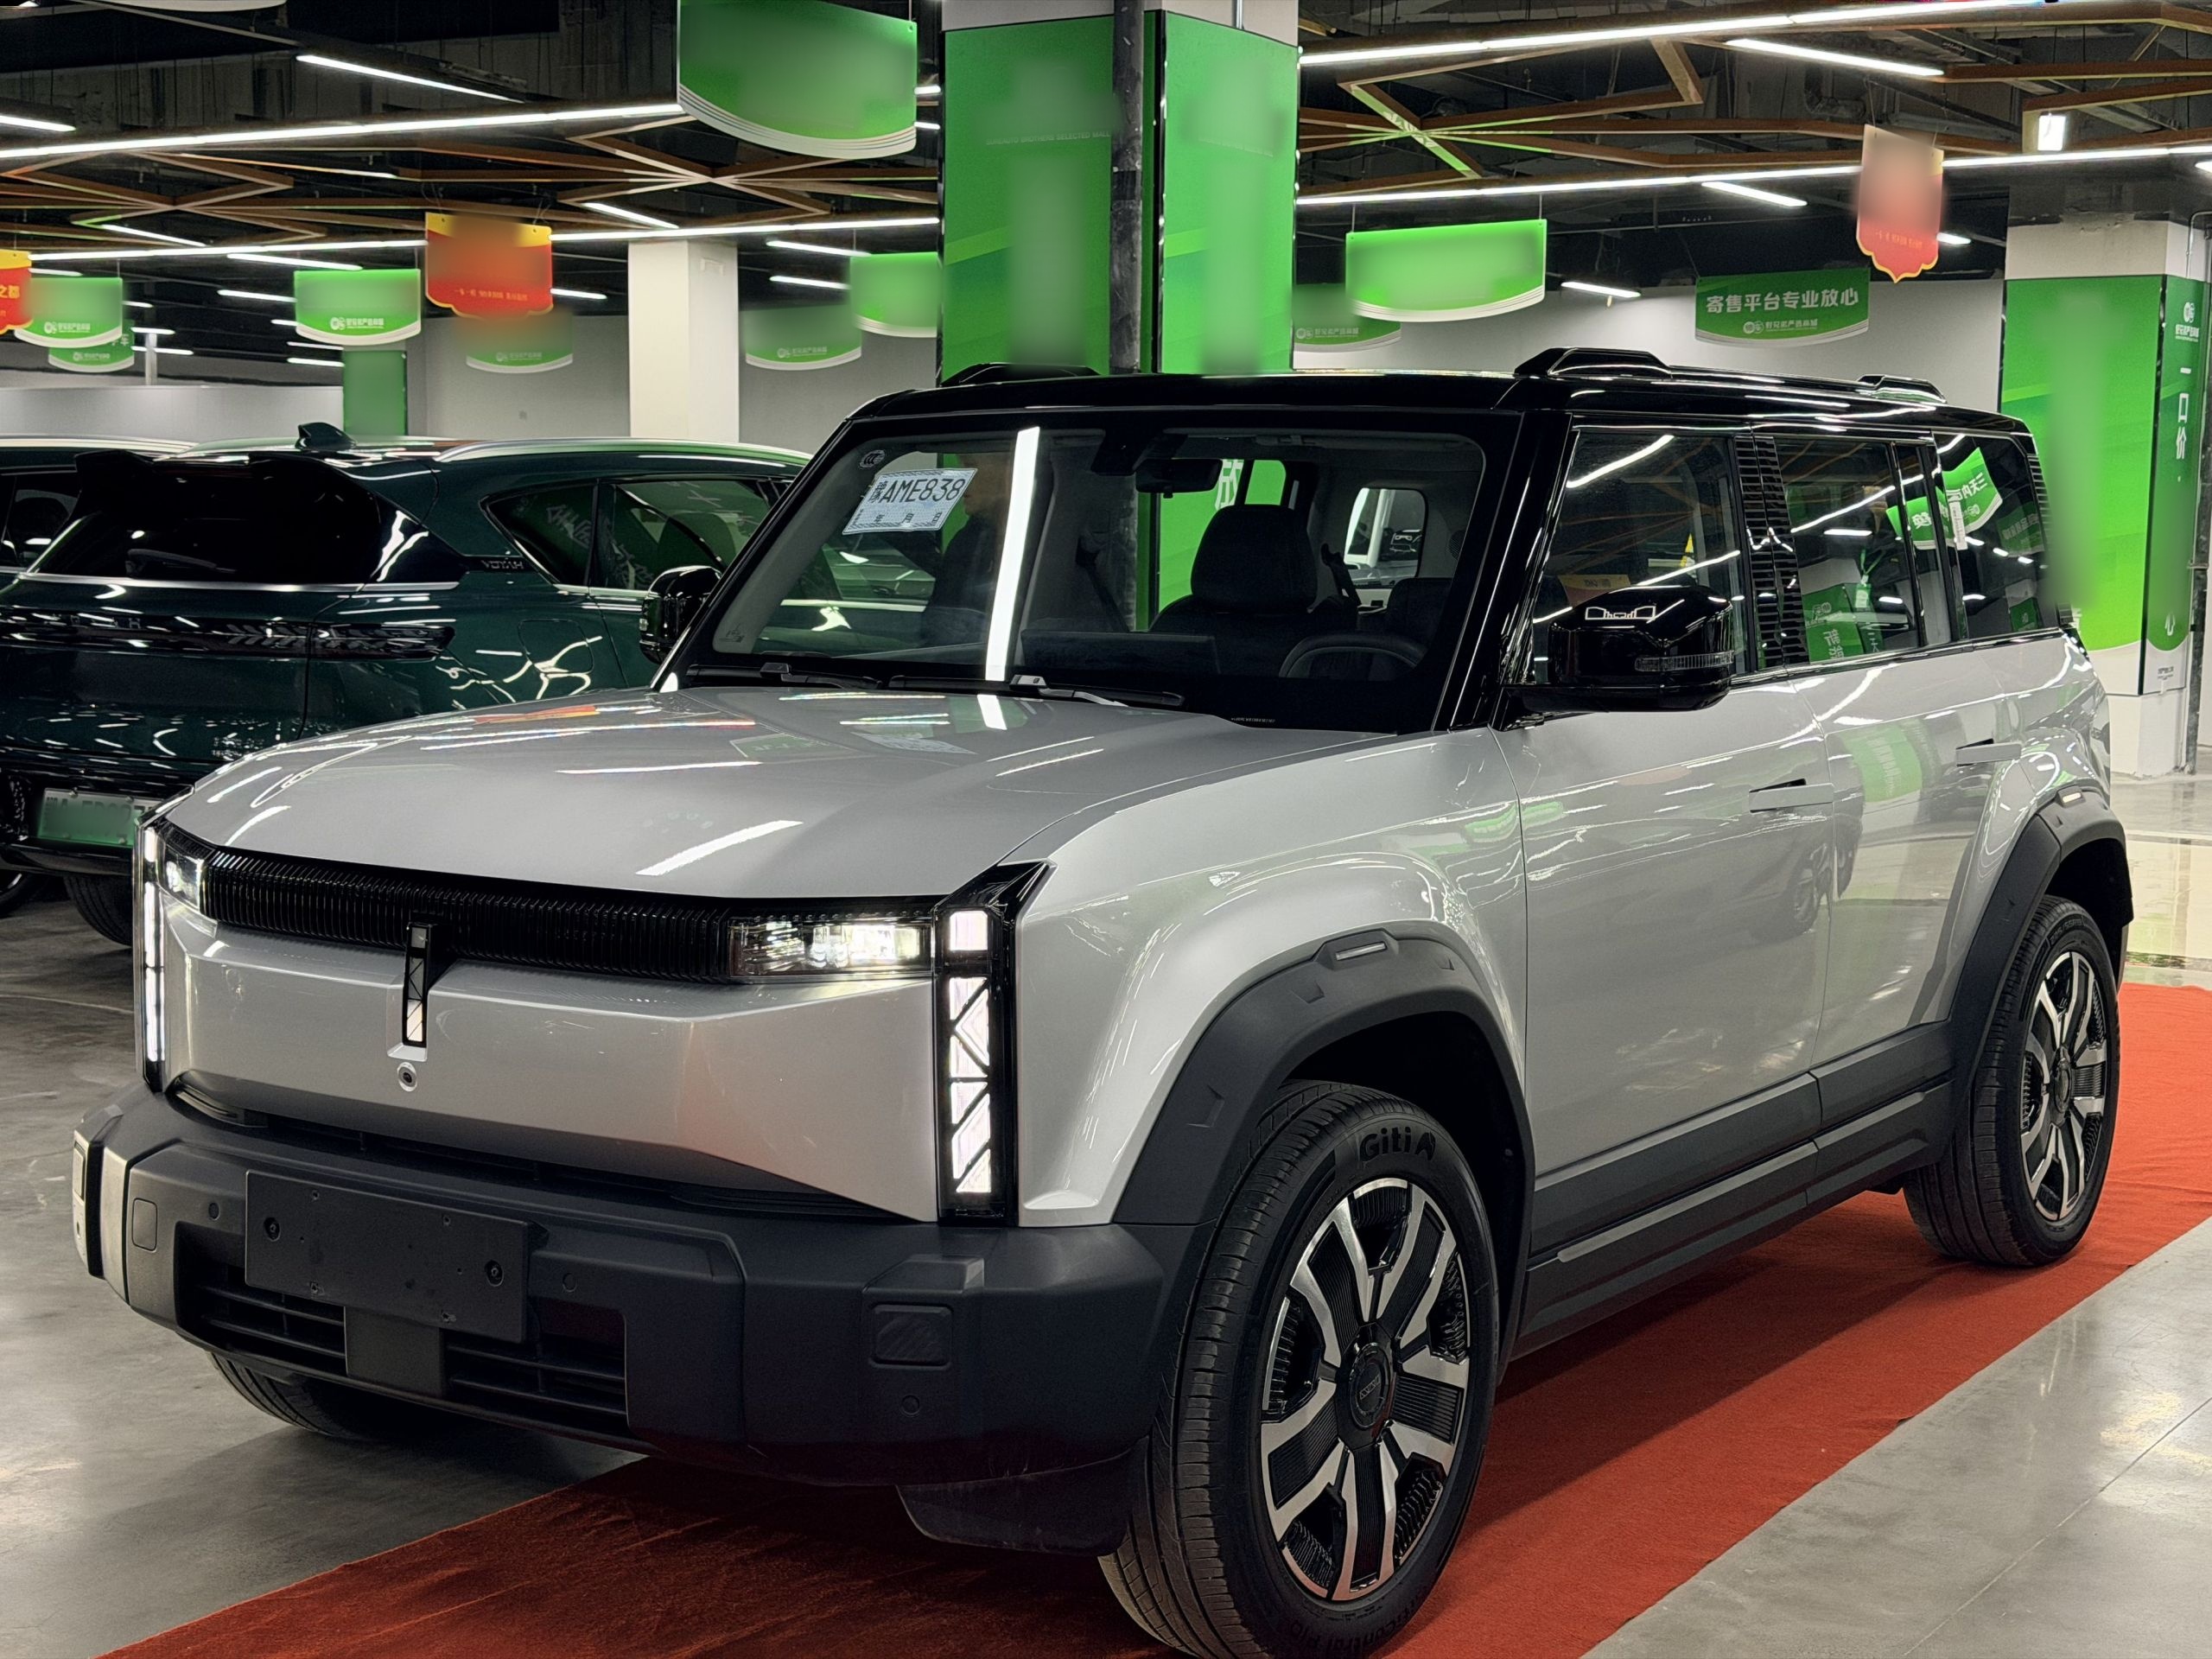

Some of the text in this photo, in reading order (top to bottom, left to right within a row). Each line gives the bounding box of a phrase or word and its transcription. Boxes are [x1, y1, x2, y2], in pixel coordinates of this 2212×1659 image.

[1056, 131, 1090, 141] SELECTED
[1706, 287, 1859, 314] 寄售平台专业放心
